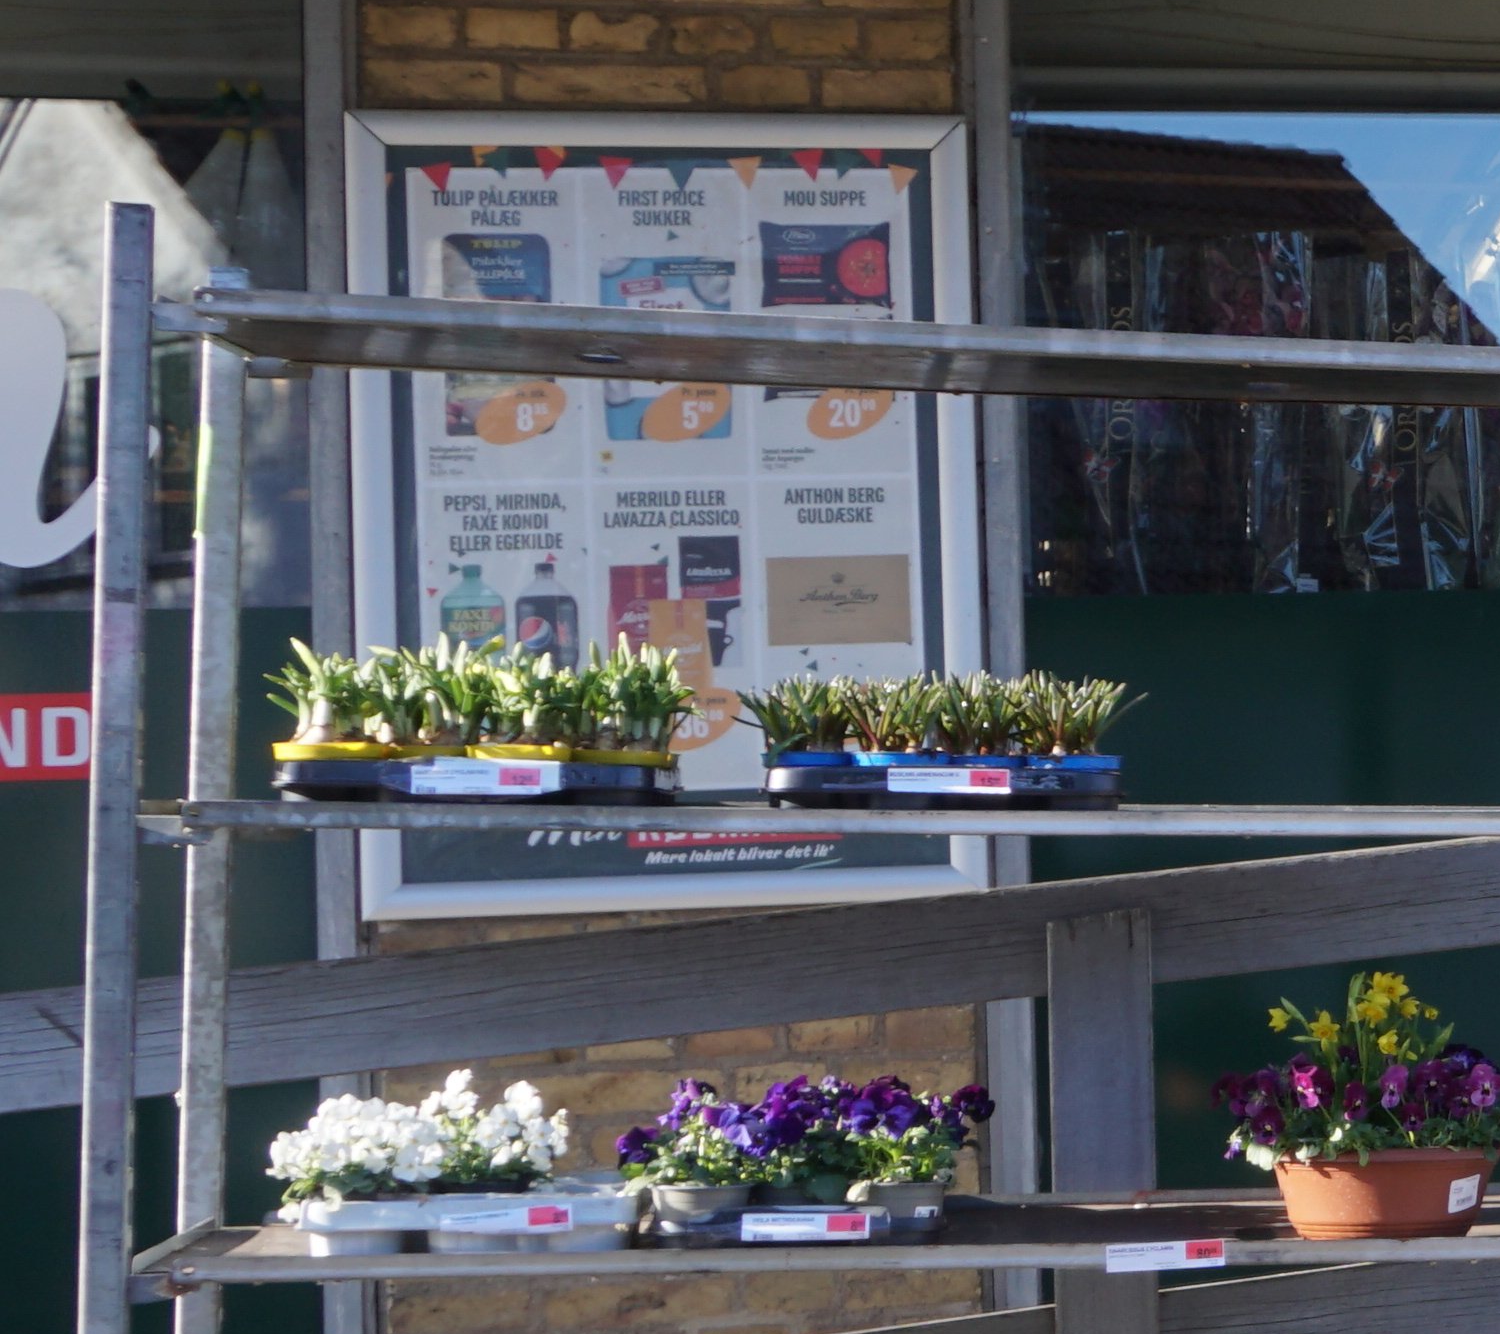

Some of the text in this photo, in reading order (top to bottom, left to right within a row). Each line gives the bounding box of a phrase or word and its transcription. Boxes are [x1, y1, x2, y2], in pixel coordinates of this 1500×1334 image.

[432, 185, 559, 206] TULIP PÅLÆKKER
[618, 190, 705, 207] FIRST PRICE
[783, 190, 867, 207] MOU SUPPE
[471, 208, 521, 226] PÅLÆG
[633, 210, 692, 226] SUKKER
[443, 493, 567, 514] PEPSI, MIRINDA,
[616, 489, 726, 507] MERRILD ELLER
[784, 487, 885, 504] ANTHON BERG
[463, 513, 549, 531] FAXE KONDI
[604, 510, 740, 528] LAVAZZA CLASSICO
[797, 507, 874, 524] GULDÆSKE
[450, 533, 563, 551] ELLER EGEKILDE
[645, 851, 686, 865] Mere
[689, 848, 735, 863] lokalt
[737, 846, 782, 862] bliver
[784, 845, 810, 859] det
